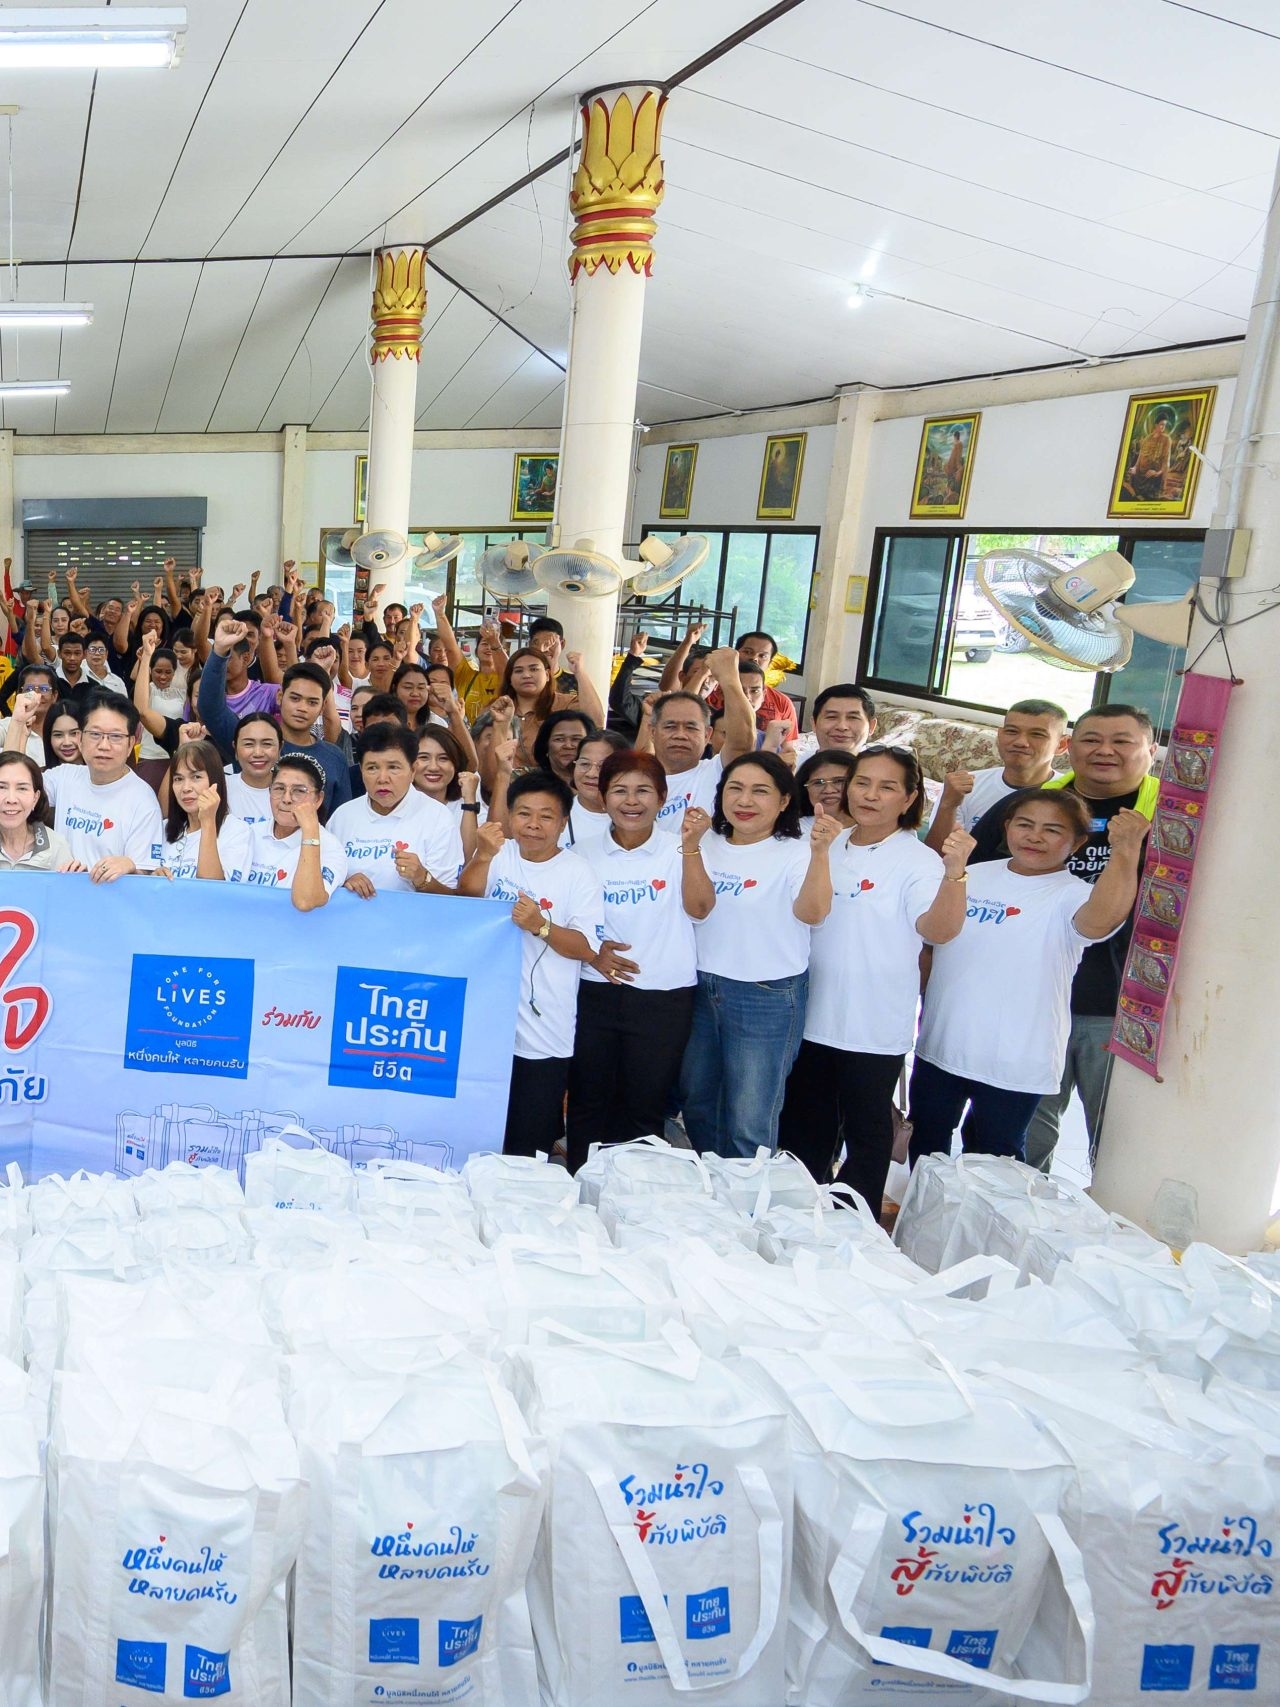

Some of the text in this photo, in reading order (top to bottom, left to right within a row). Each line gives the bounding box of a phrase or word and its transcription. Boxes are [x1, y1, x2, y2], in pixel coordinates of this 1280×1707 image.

[165, 966, 220, 986] ONE FOR
[359, 983, 429, 1020] ไทย
[163, 1005, 218, 1028] FOUNDATION
[261, 1006, 322, 1029] ร่วมกับ
[345, 1017, 447, 1053] ประกัน
[128, 1049, 245, 1069] หนึ่งคนให้ หลายคนรับ
[372, 1060, 413, 1081] ชีวิต
[620, 1463, 724, 1506] รวมน้ำใจ
[902, 1503, 1016, 1547] รวมน้ำใจ
[1158, 1516, 1272, 1557] รวมน้ำใจ
[378, 1558, 490, 1580] หลายคนรับ
[890, 1546, 1013, 1596] สู้ภัยพิบัติ
[128, 1578, 237, 1605] หลายคนรับ
[698, 1596, 719, 1608] ไทย
[692, 1607, 726, 1623] ประกัน
